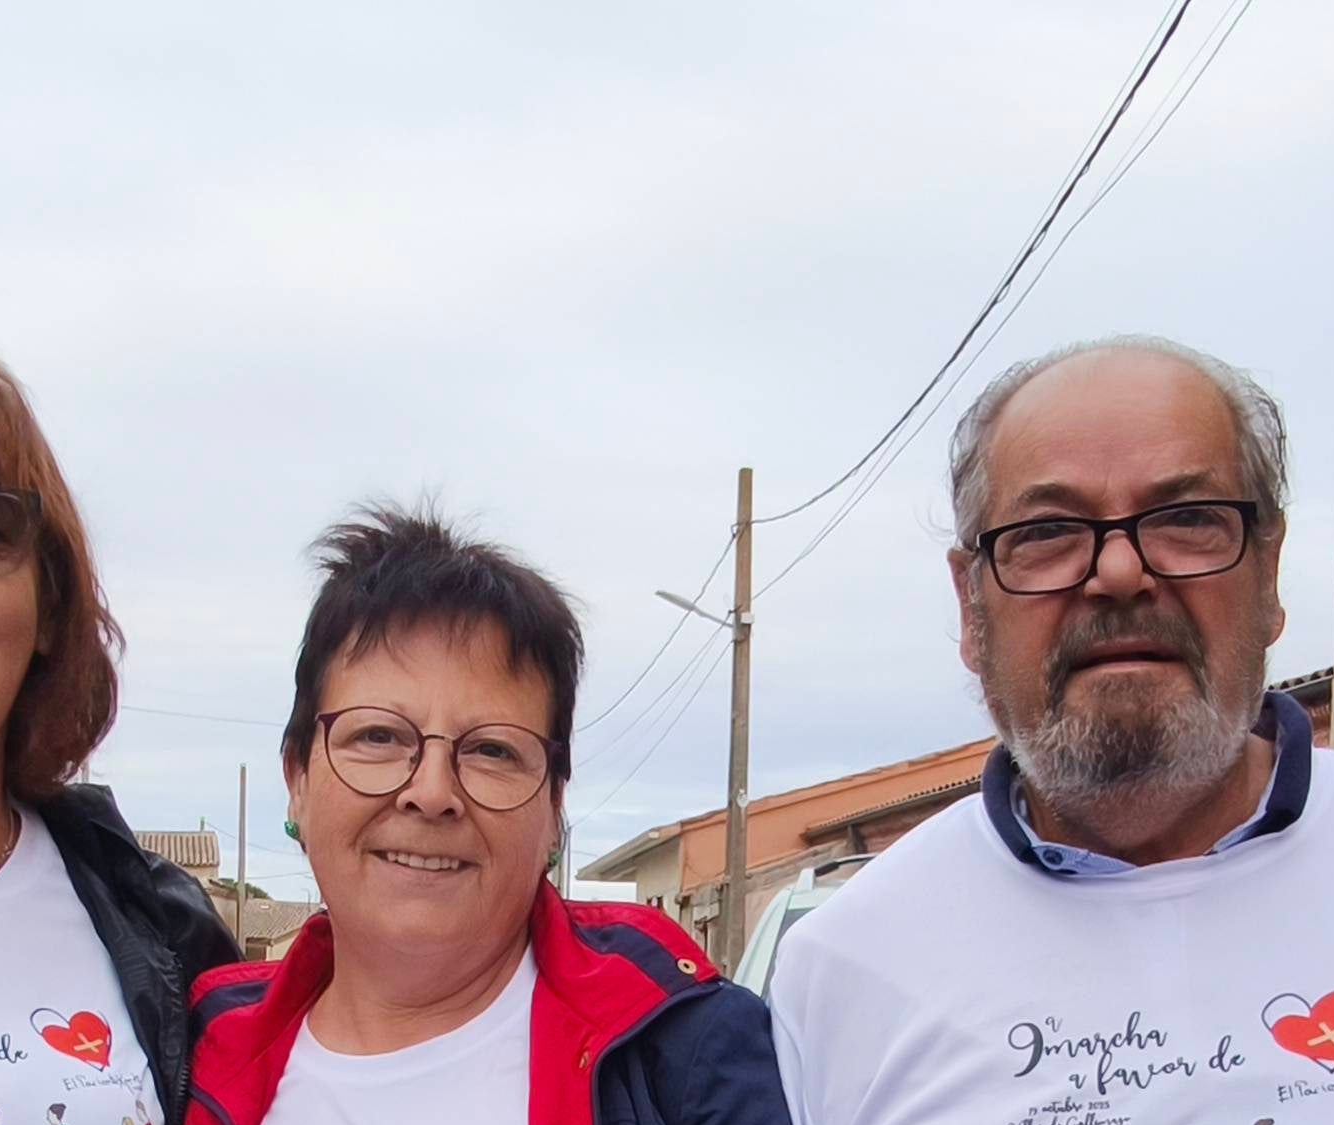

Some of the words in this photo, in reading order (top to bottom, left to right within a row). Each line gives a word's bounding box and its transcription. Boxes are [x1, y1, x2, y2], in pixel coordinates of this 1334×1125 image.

[1043, 1011, 1167, 1058] marcha
[1069, 1072, 1087, 1089] a
[1097, 1051, 1197, 1095] favor
[1209, 1035, 1245, 1073] de
[1277, 1085, 1293, 1102] El
